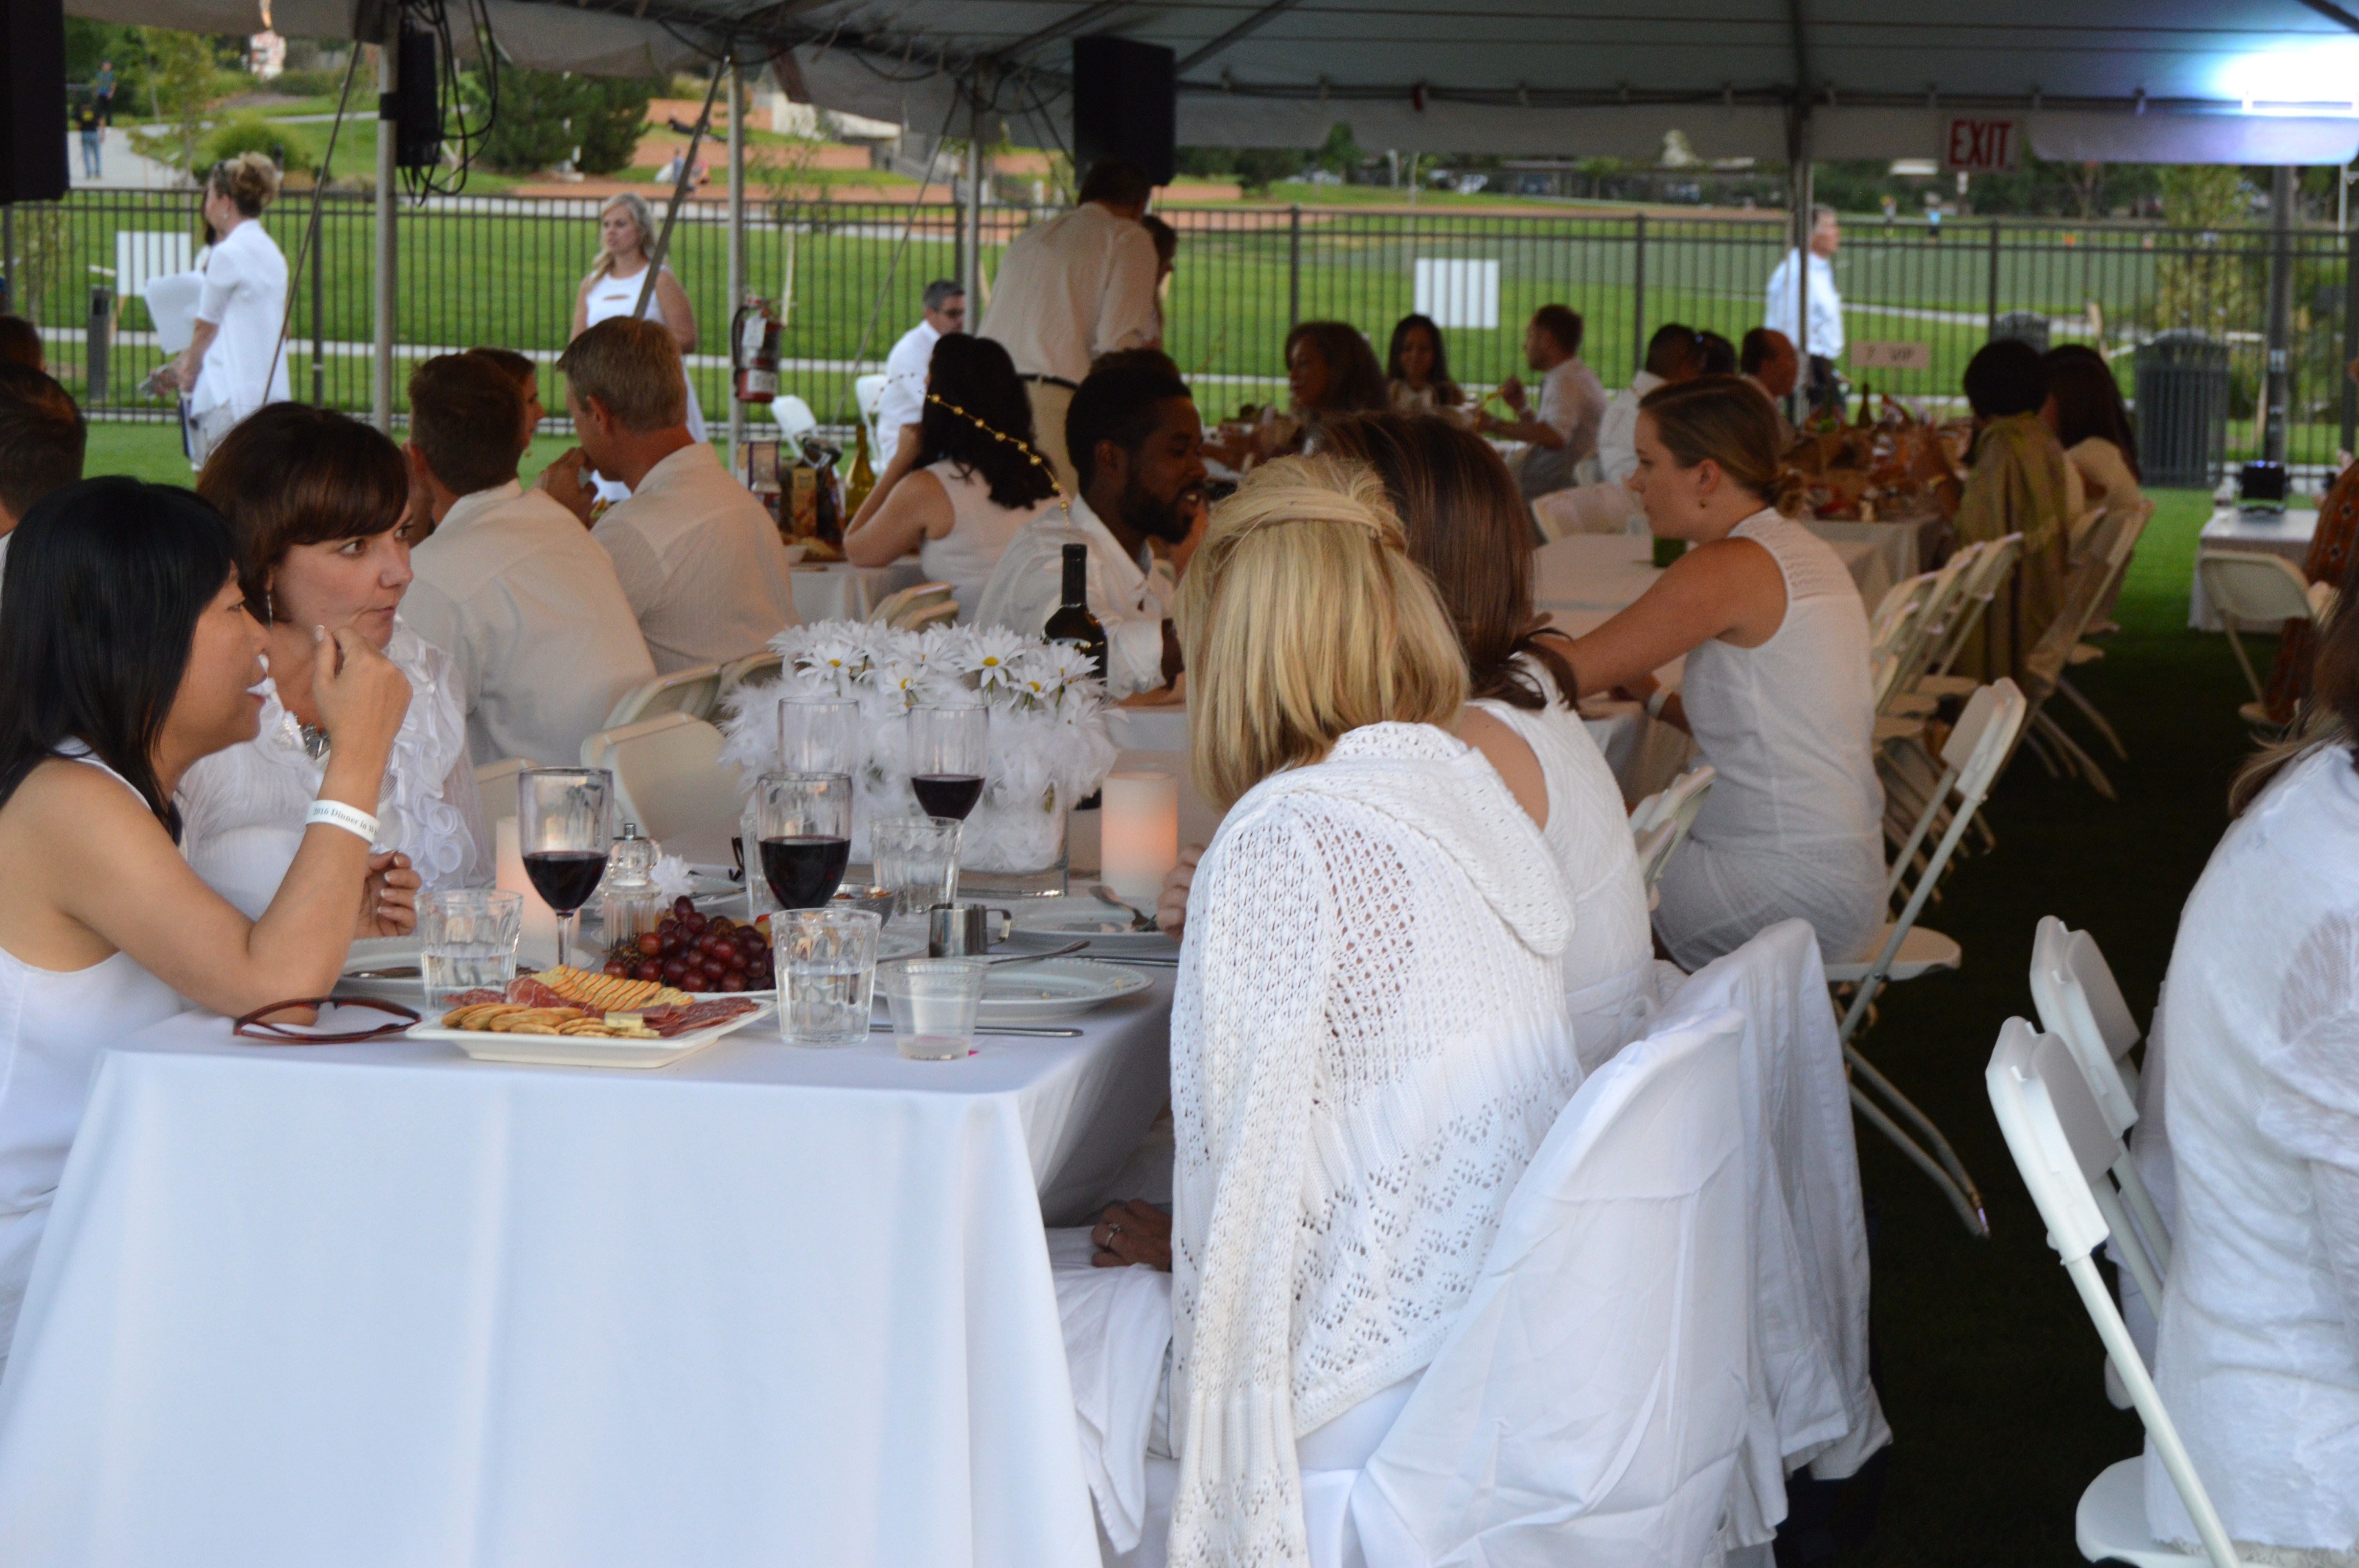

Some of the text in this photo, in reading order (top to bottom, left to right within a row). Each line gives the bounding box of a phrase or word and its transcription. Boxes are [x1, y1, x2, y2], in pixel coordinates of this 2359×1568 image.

[1950, 121, 2012, 166] EXIT
[331, 809, 358, 824] Dinner
[360, 820, 367, 830] in
